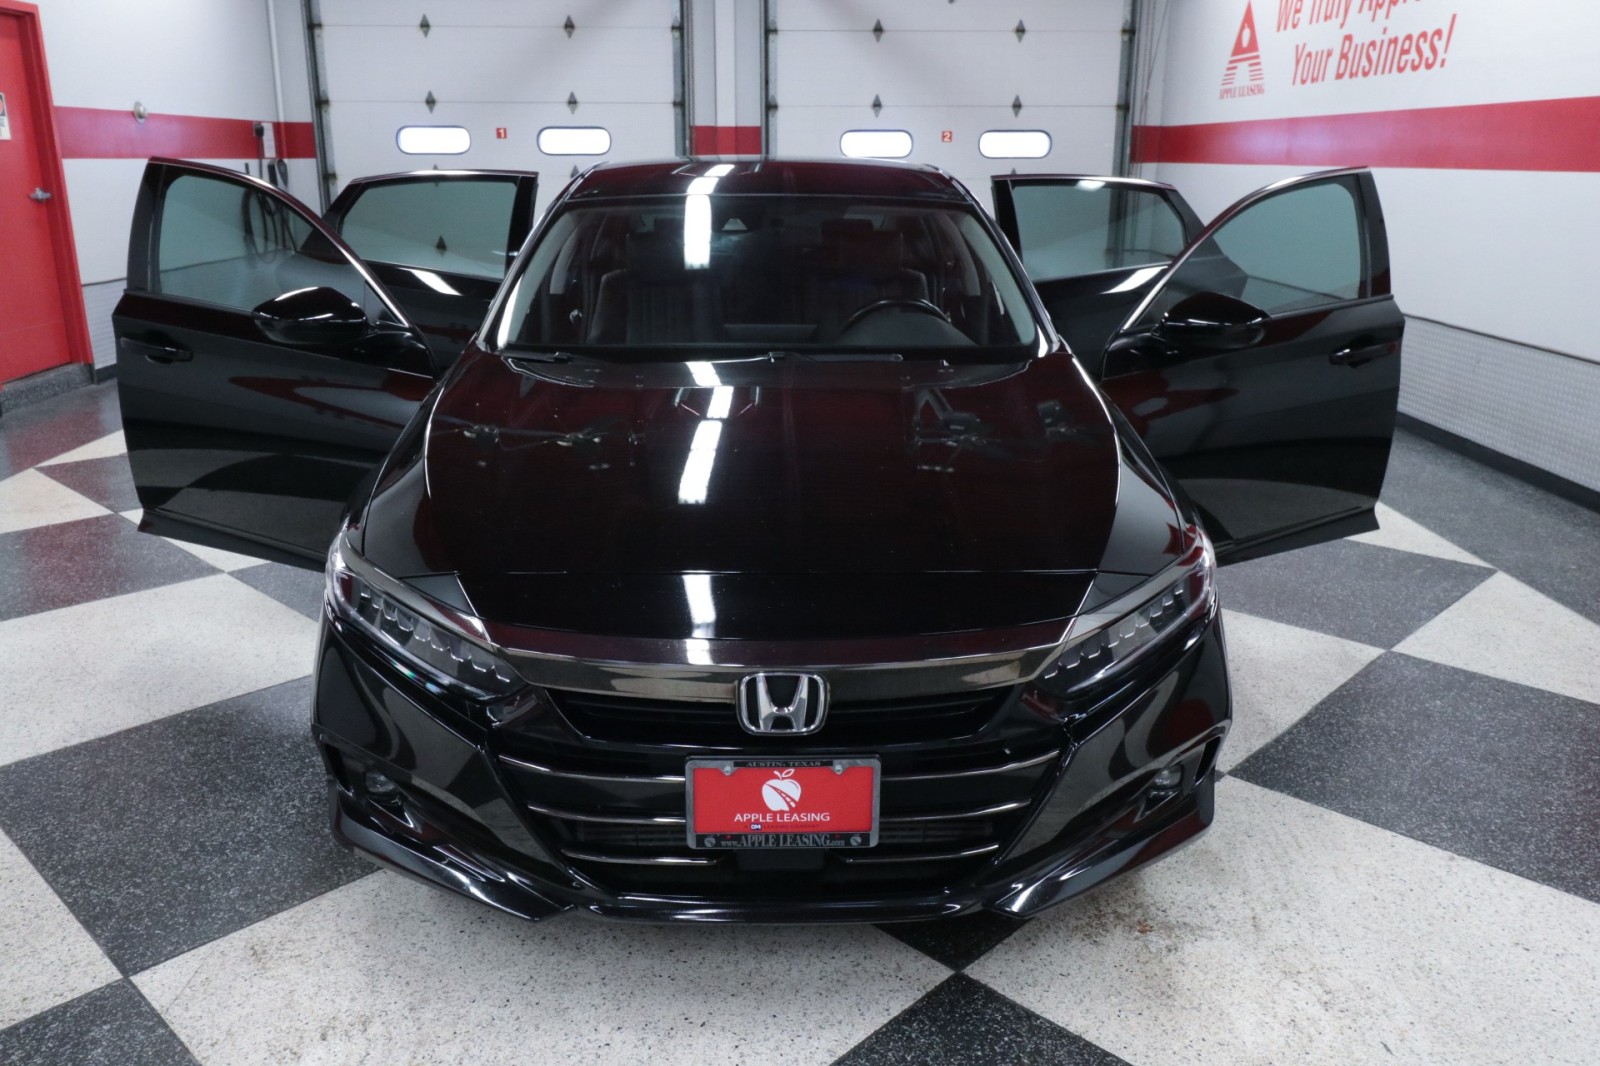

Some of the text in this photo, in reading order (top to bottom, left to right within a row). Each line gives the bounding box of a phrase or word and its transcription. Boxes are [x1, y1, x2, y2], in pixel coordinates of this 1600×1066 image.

[1276, 0, 1304, 32] We
[1292, 13, 1457, 86] Your Business!
[734, 812, 830, 823] APPLE LEASING
